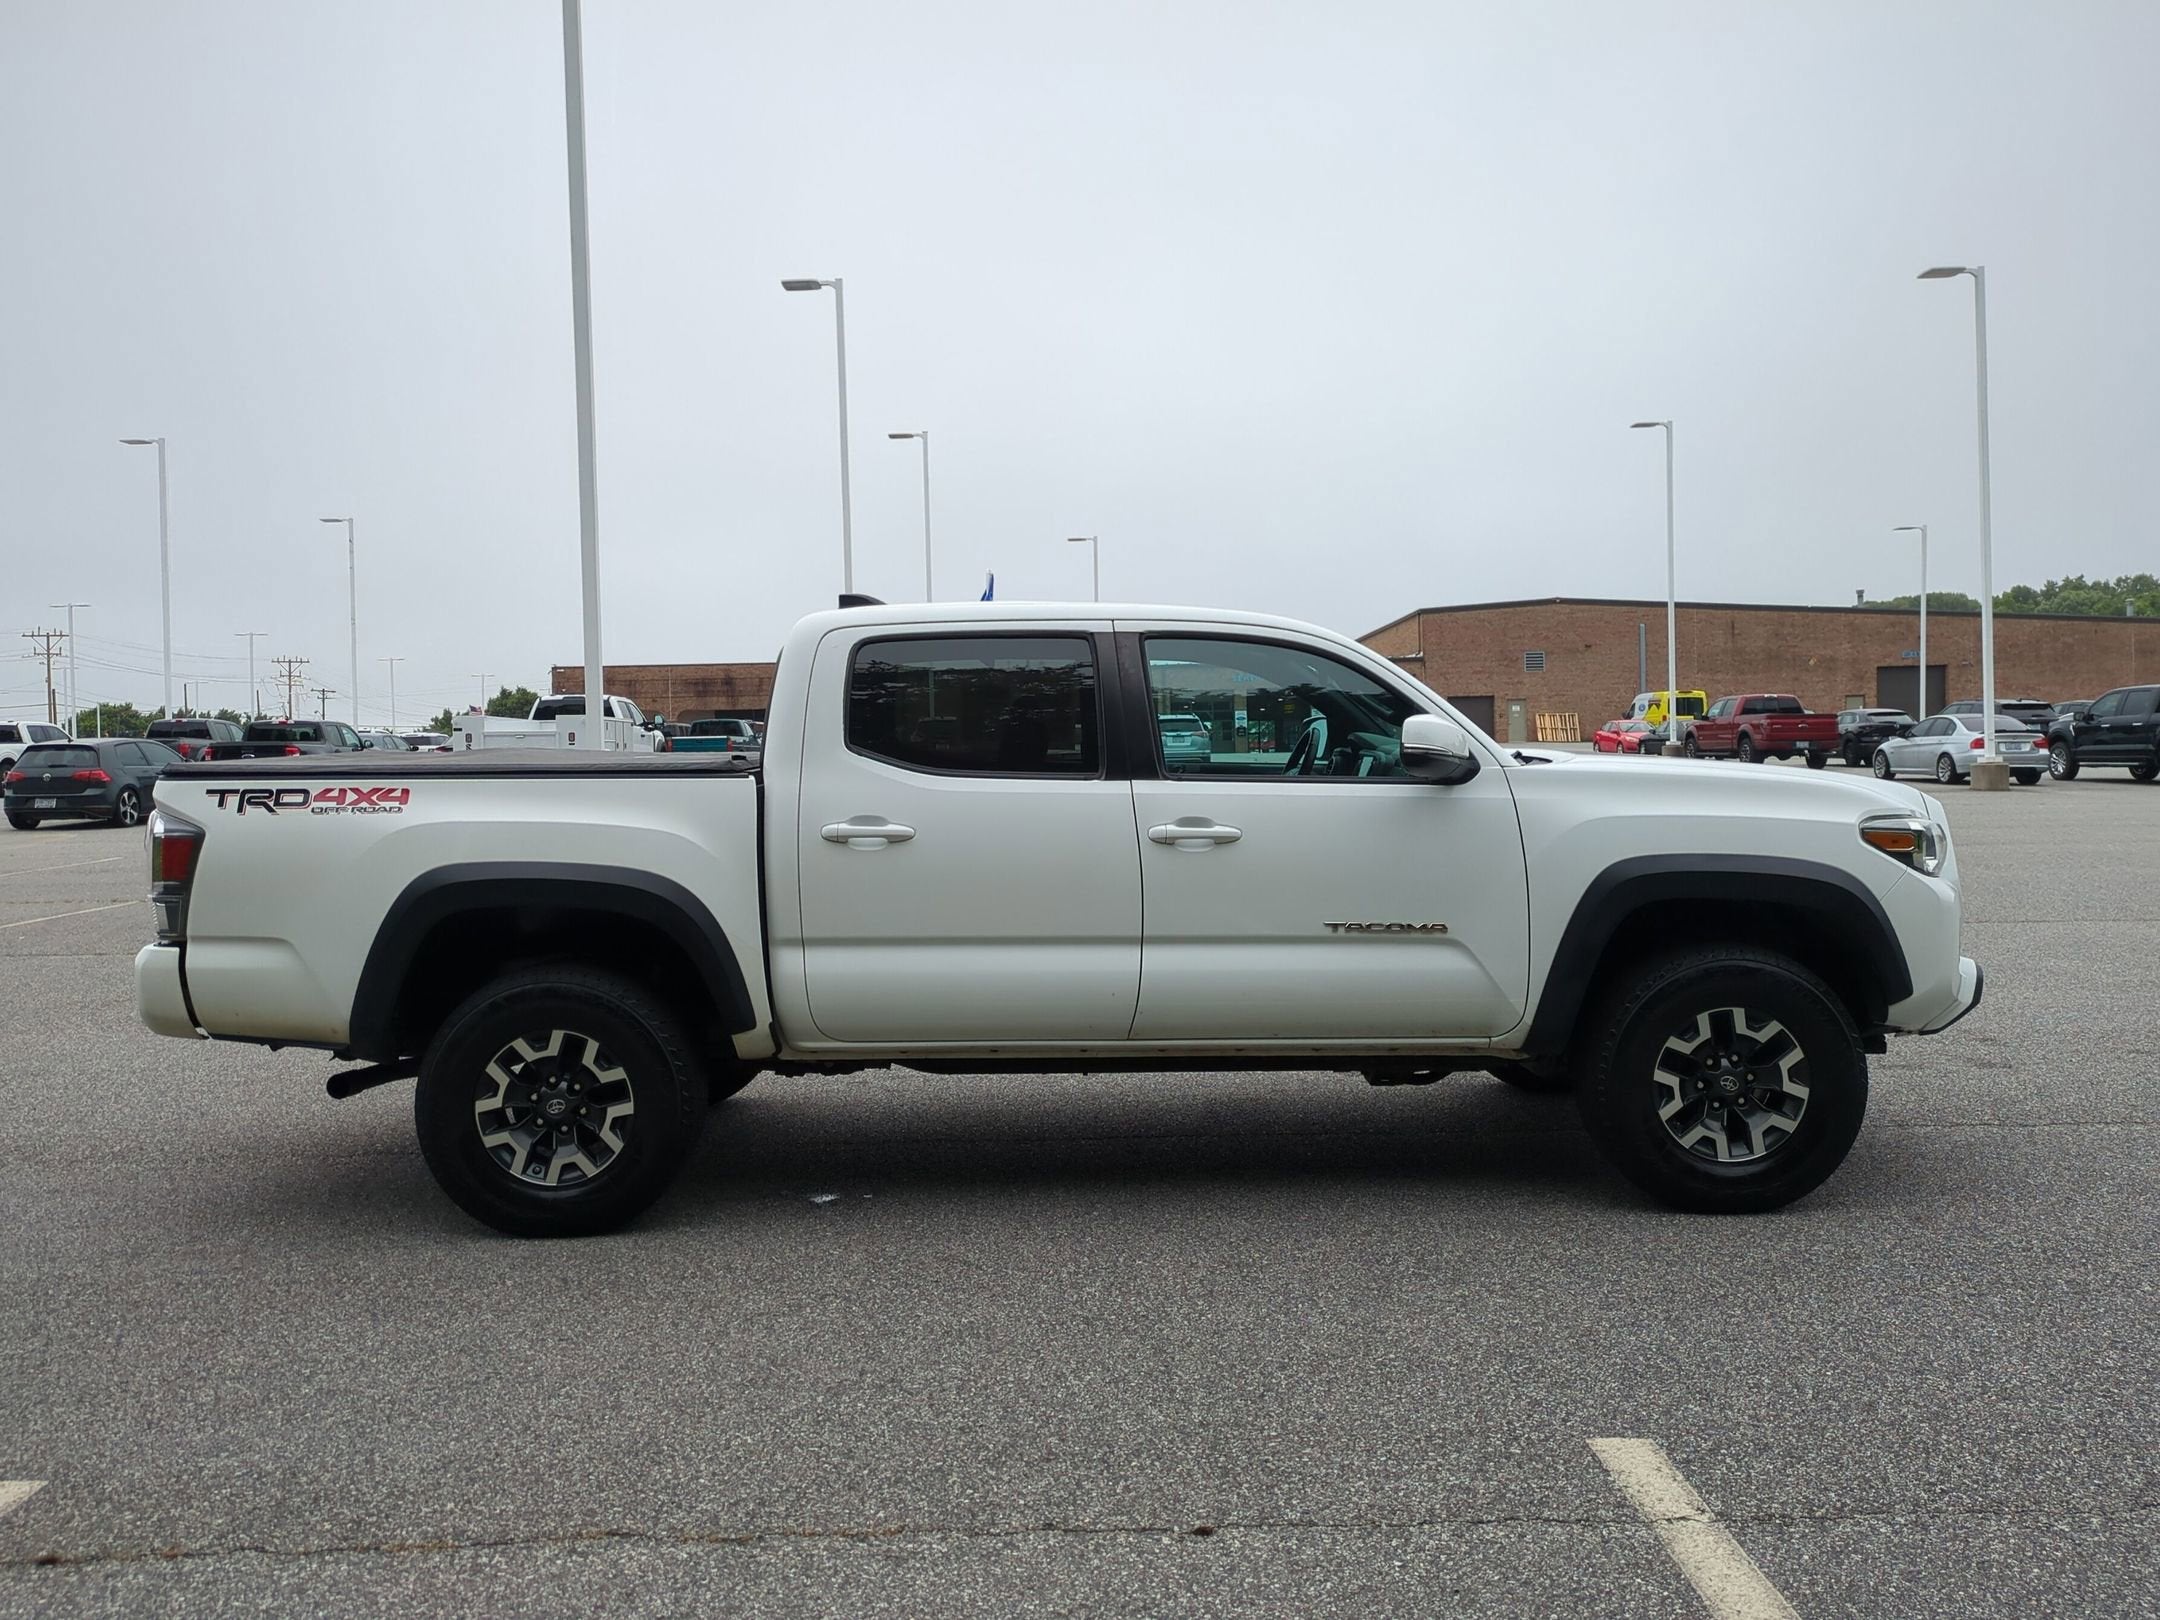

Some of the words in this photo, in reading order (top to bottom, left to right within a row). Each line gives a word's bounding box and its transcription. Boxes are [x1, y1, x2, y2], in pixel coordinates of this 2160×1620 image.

[205, 788, 313, 816] TRD
[312, 787, 410, 807] 4X4
[310, 806, 350, 815] OFF
[350, 806, 403, 815] ROAD
[1323, 921, 1448, 934] TACOMA
